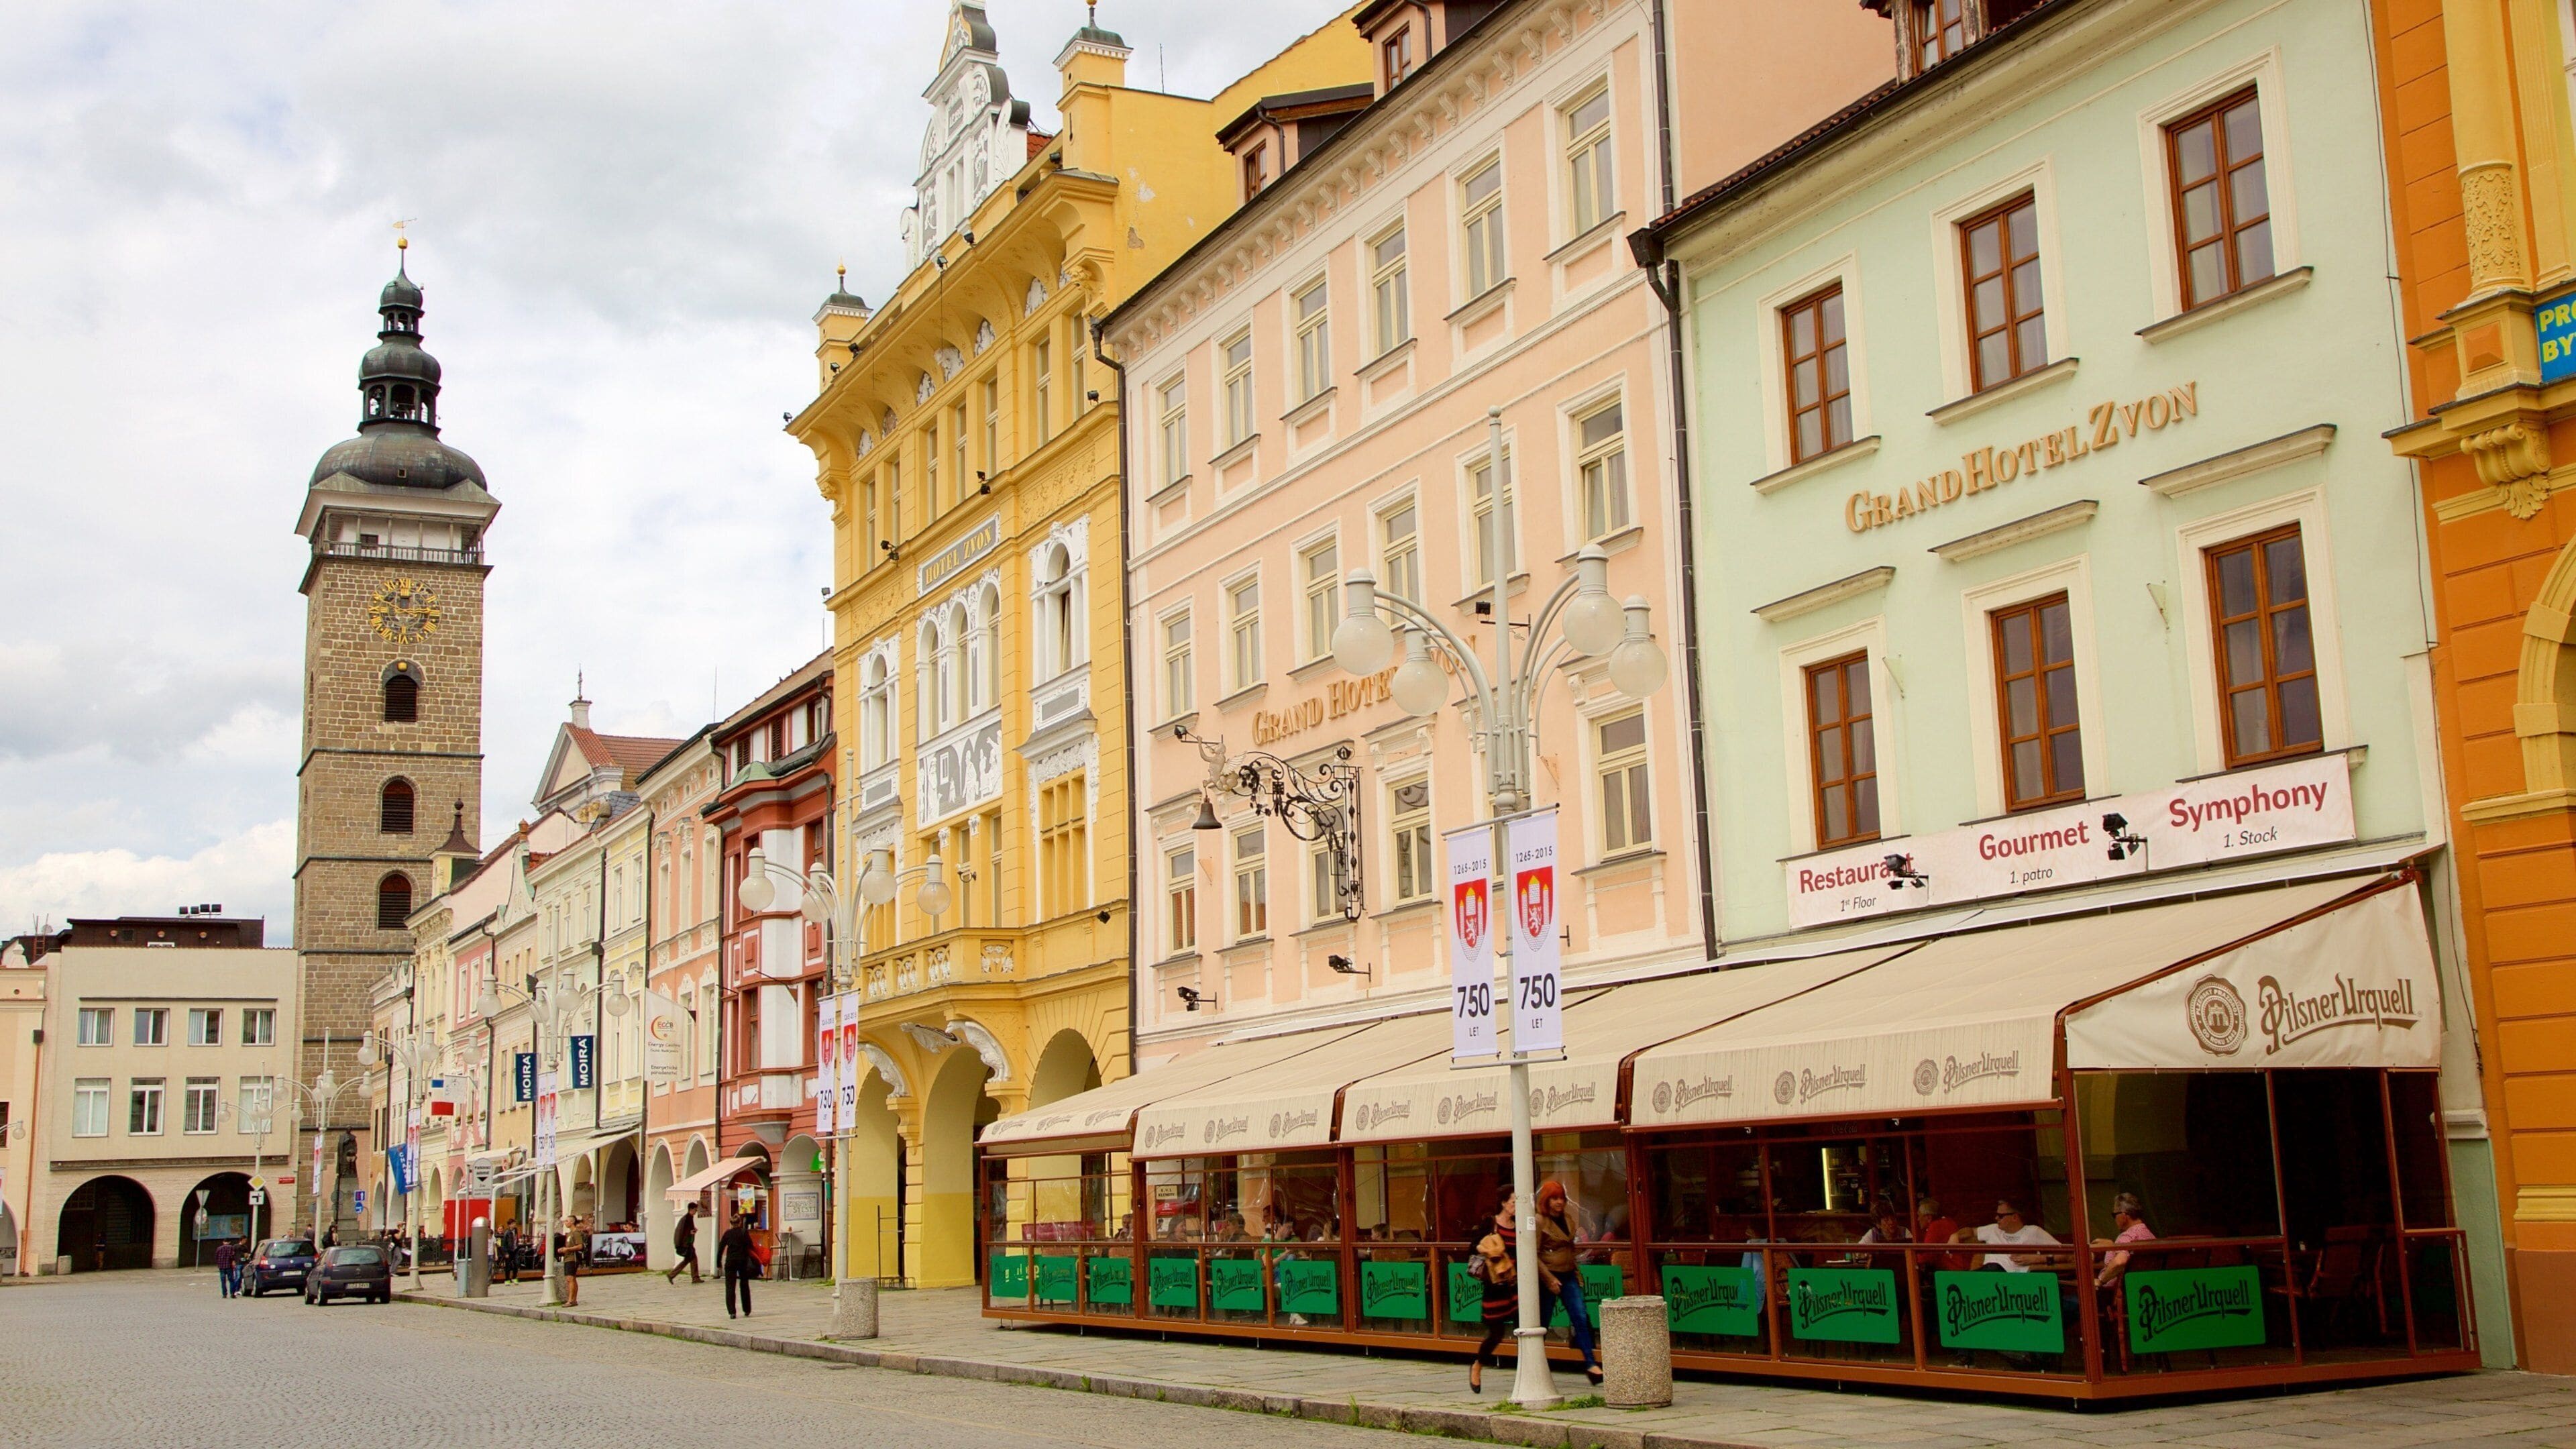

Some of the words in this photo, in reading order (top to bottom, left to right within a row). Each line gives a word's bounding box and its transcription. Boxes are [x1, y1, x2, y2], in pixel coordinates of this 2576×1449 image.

[2542, 331, 2576, 362] BY
[1845, 468, 1962, 533] GRAND
[1962, 425, 2088, 496] HOTEL
[2088, 380, 2197, 451] ZVON
[925, 554, 960, 585] HOTEL
[963, 527, 992, 560] ZVON
[1252, 697, 1324, 746] GRAND
[2169, 782, 2327, 833] Symphony
[1515, 845, 1553, 863] 1265-2015
[1980, 820, 2090, 861] Gourmet
[2224, 833, 2234, 848] 1.
[2239, 826, 2278, 846] Stock
[1454, 859, 1487, 875] 1265-2015
[1800, 853, 1916, 894] Restaurat
[2010, 871, 2019, 884] 1.
[2023, 868, 2053, 885] patro
[1853, 896, 1877, 910] Floor
[1458, 983, 1490, 1018] 750
[1520, 973, 1555, 1010] 750
[1469, 1026, 1480, 1037] LET
[1532, 1018, 1543, 1029] LET
[2258, 975, 2341, 1055] Pilsner
[2334, 973, 2416, 1031] Urquell
[523, 1055, 531, 1099] MOIRA
[579, 1038, 589, 1086] MOIRA
[1943, 1055, 1982, 1094] Pilsner
[1981, 1051, 2019, 1079] Urquell
[820, 1089, 833, 1109] 750
[842, 1084, 855, 1106] 750
[1546, 1085, 1572, 1117] Pilsner
[1572, 1081, 1595, 1104] Urquell
[1675, 1079, 1705, 1112] Pilsner
[1704, 1075, 1733, 1100] Urquell
[1800, 1068, 1834, 1105] Pilsner
[1833, 1064, 1866, 1091] Urquell
[1371, 1102, 1392, 1130] Pilsner
[1391, 1100, 1411, 1120] Urquell
[1454, 1095, 1477, 1124] Pilsner
[1477, 1091, 1498, 1113] Urquell
[1366, 1271, 1393, 1309] Pilsner
[1671, 1277, 1709, 1323] Pilsner
[1799, 1280, 1843, 1330] Pilsner
[1839, 1279, 1887, 1317] Urquell
[1947, 1283, 1998, 1338] Pilsner
[1994, 1281, 2049, 1324] Urquell
[2139, 1285, 2196, 1343] Pilsner
[2192, 1279, 2251, 1321] Urquell
